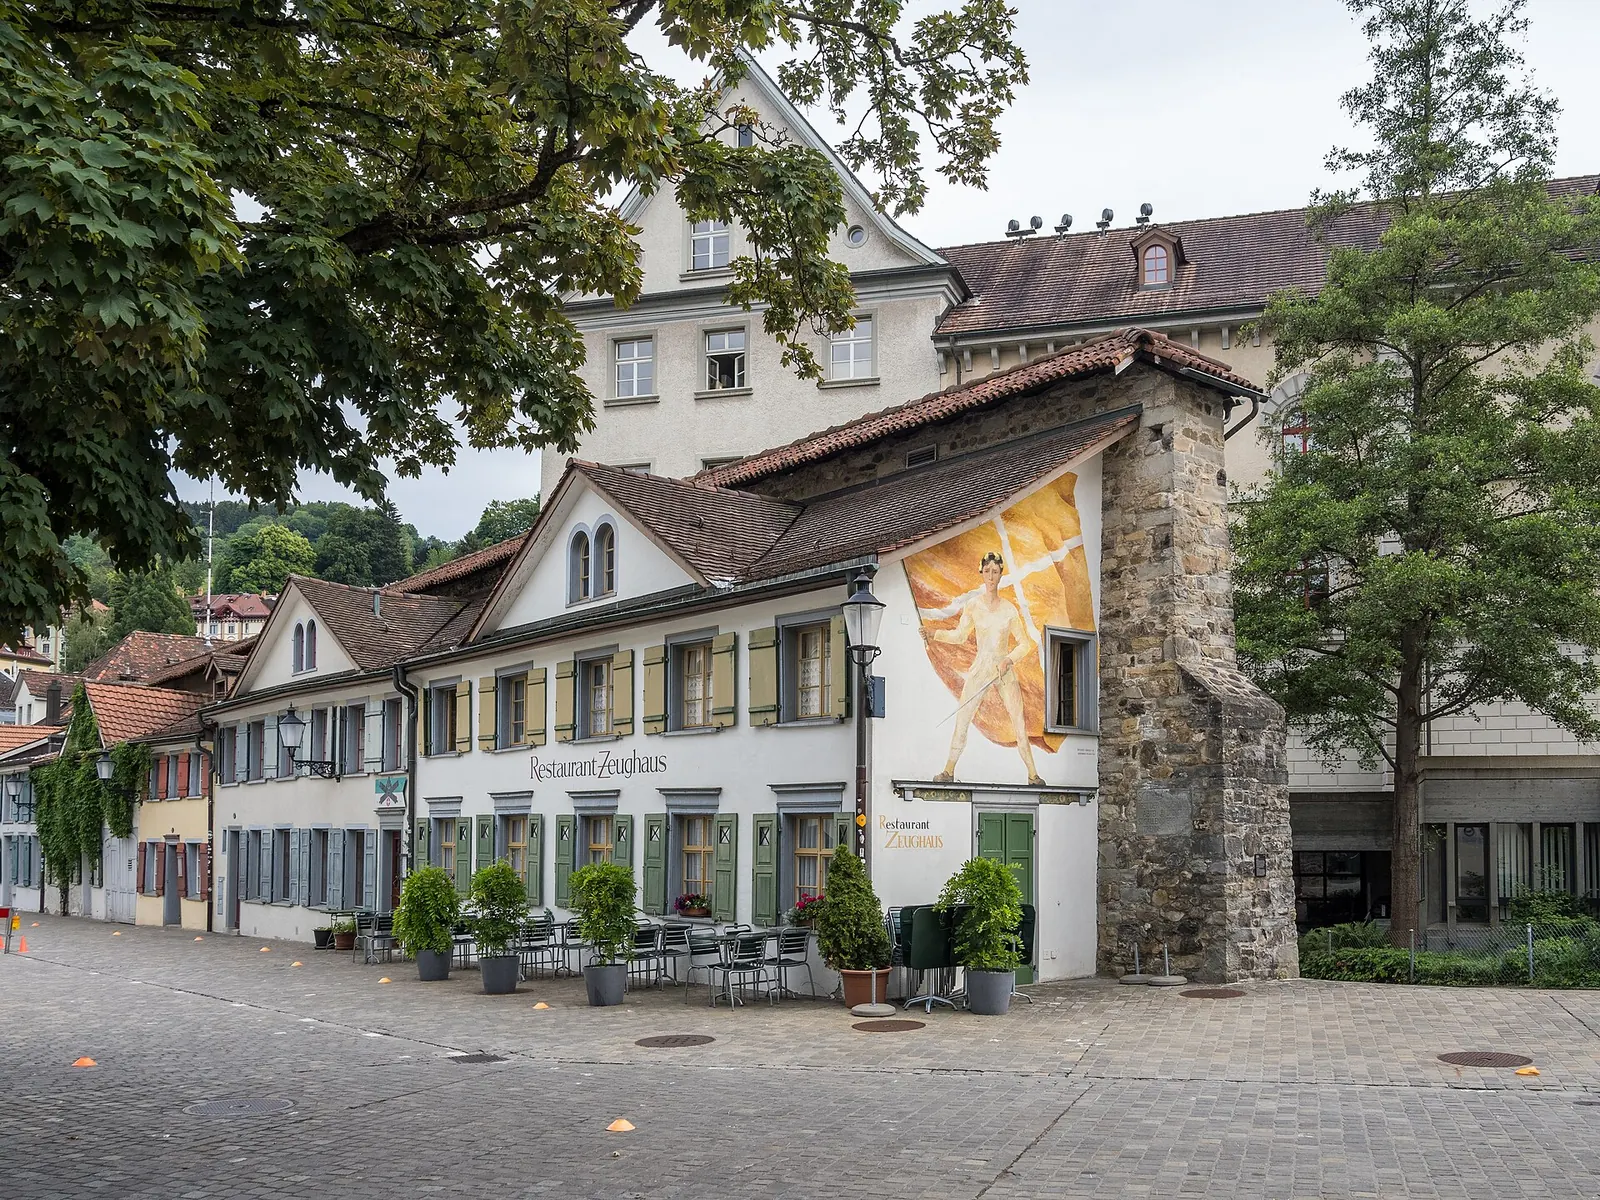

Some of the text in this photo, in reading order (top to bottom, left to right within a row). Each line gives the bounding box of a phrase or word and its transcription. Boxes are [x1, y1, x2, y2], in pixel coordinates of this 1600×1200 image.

[530, 749, 667, 782] Restaurant Zeughaus
[878, 814, 930, 830] Restaurant
[884, 830, 943, 849] ZEUGHAUS
